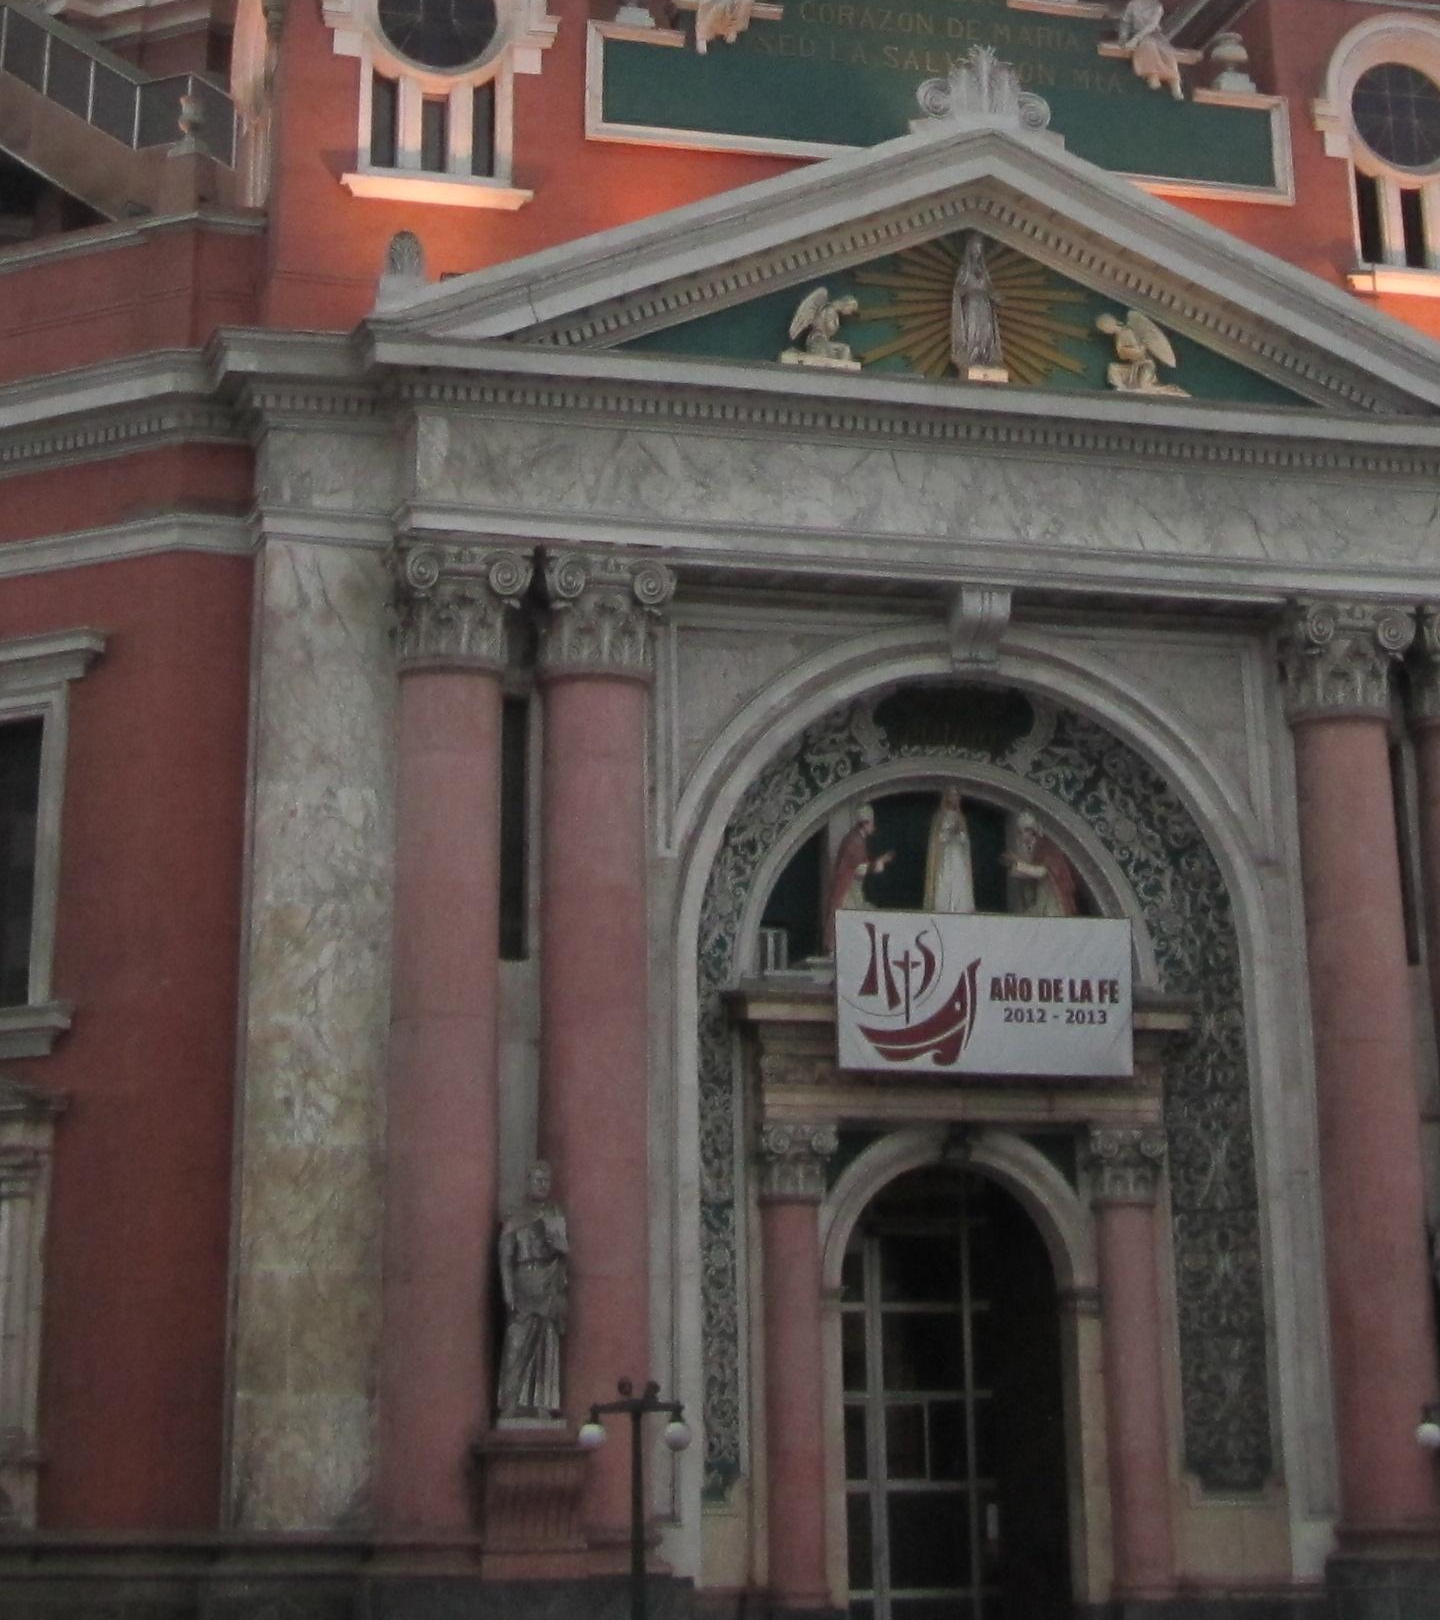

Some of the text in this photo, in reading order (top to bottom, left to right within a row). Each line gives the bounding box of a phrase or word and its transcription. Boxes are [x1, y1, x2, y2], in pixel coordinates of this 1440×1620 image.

[799, 1, 1079, 49] CORAZON DE MARIA
[830, 38, 867, 64] LA
[990, 973, 1119, 1004] AÑO DE LA FE
[1003, 1007, 1047, 1023] 2012
[1065, 1008, 1108, 1025] 2013
